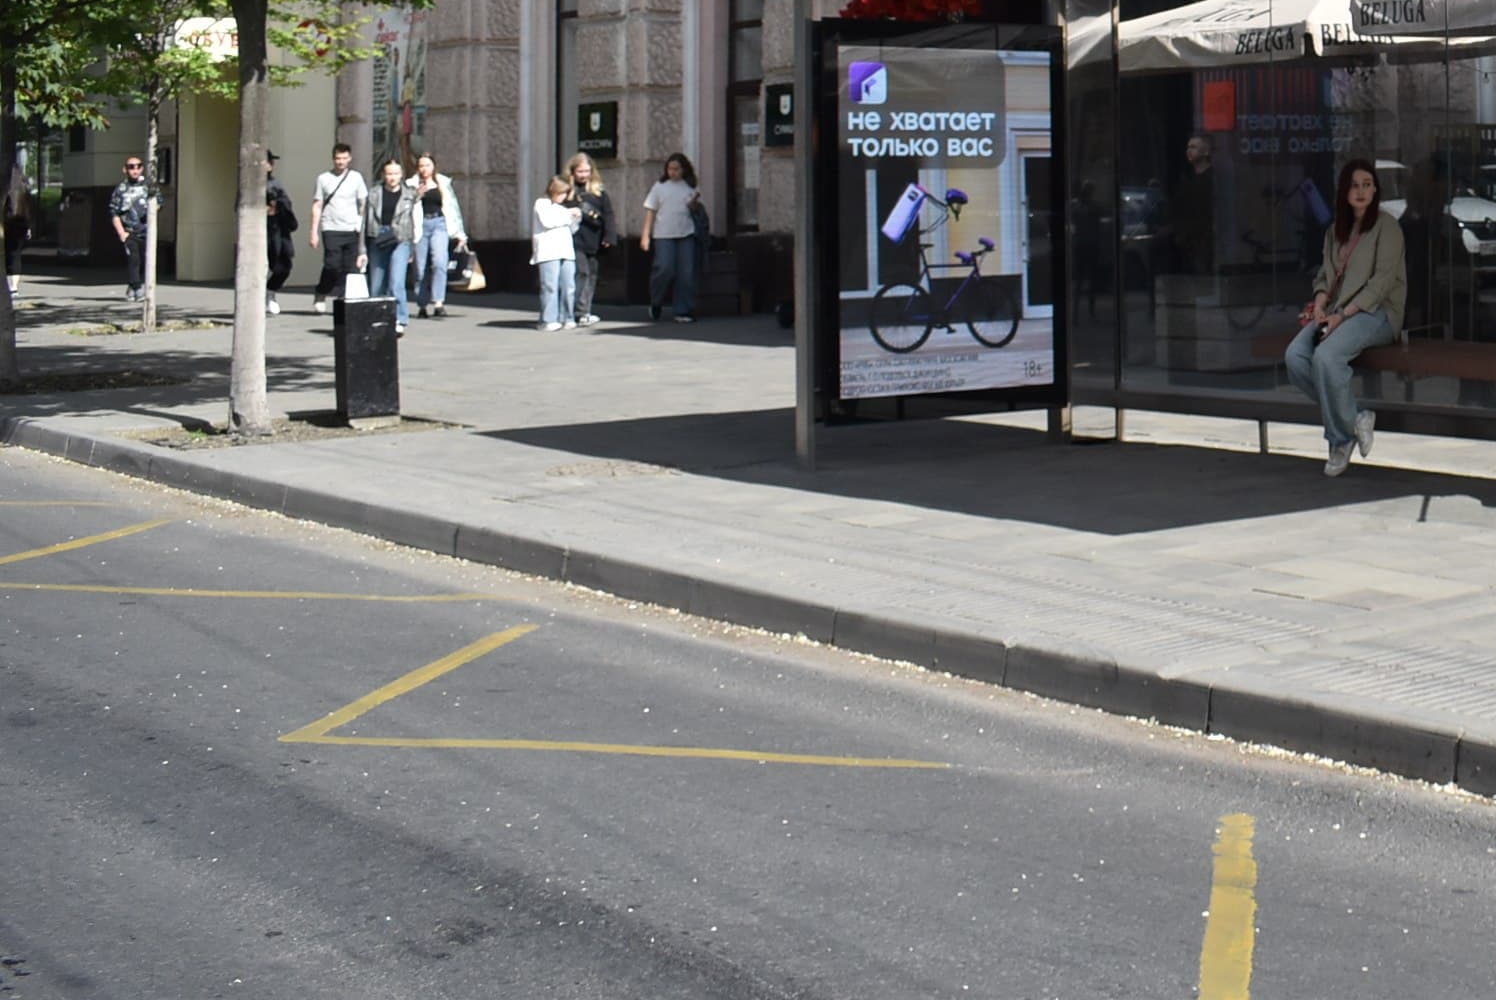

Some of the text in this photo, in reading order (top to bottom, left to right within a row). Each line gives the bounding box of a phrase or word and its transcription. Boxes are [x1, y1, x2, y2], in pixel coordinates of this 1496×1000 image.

[1361, 0, 1425, 26] BELUGA
[188, 30, 239, 48] ОБУВ
[1235, 27, 1295, 56] BELUGA
[848, 112, 995, 131] не хватает
[847, 138, 993, 157] только вас
[1023, 360, 1043, 377] 18+
